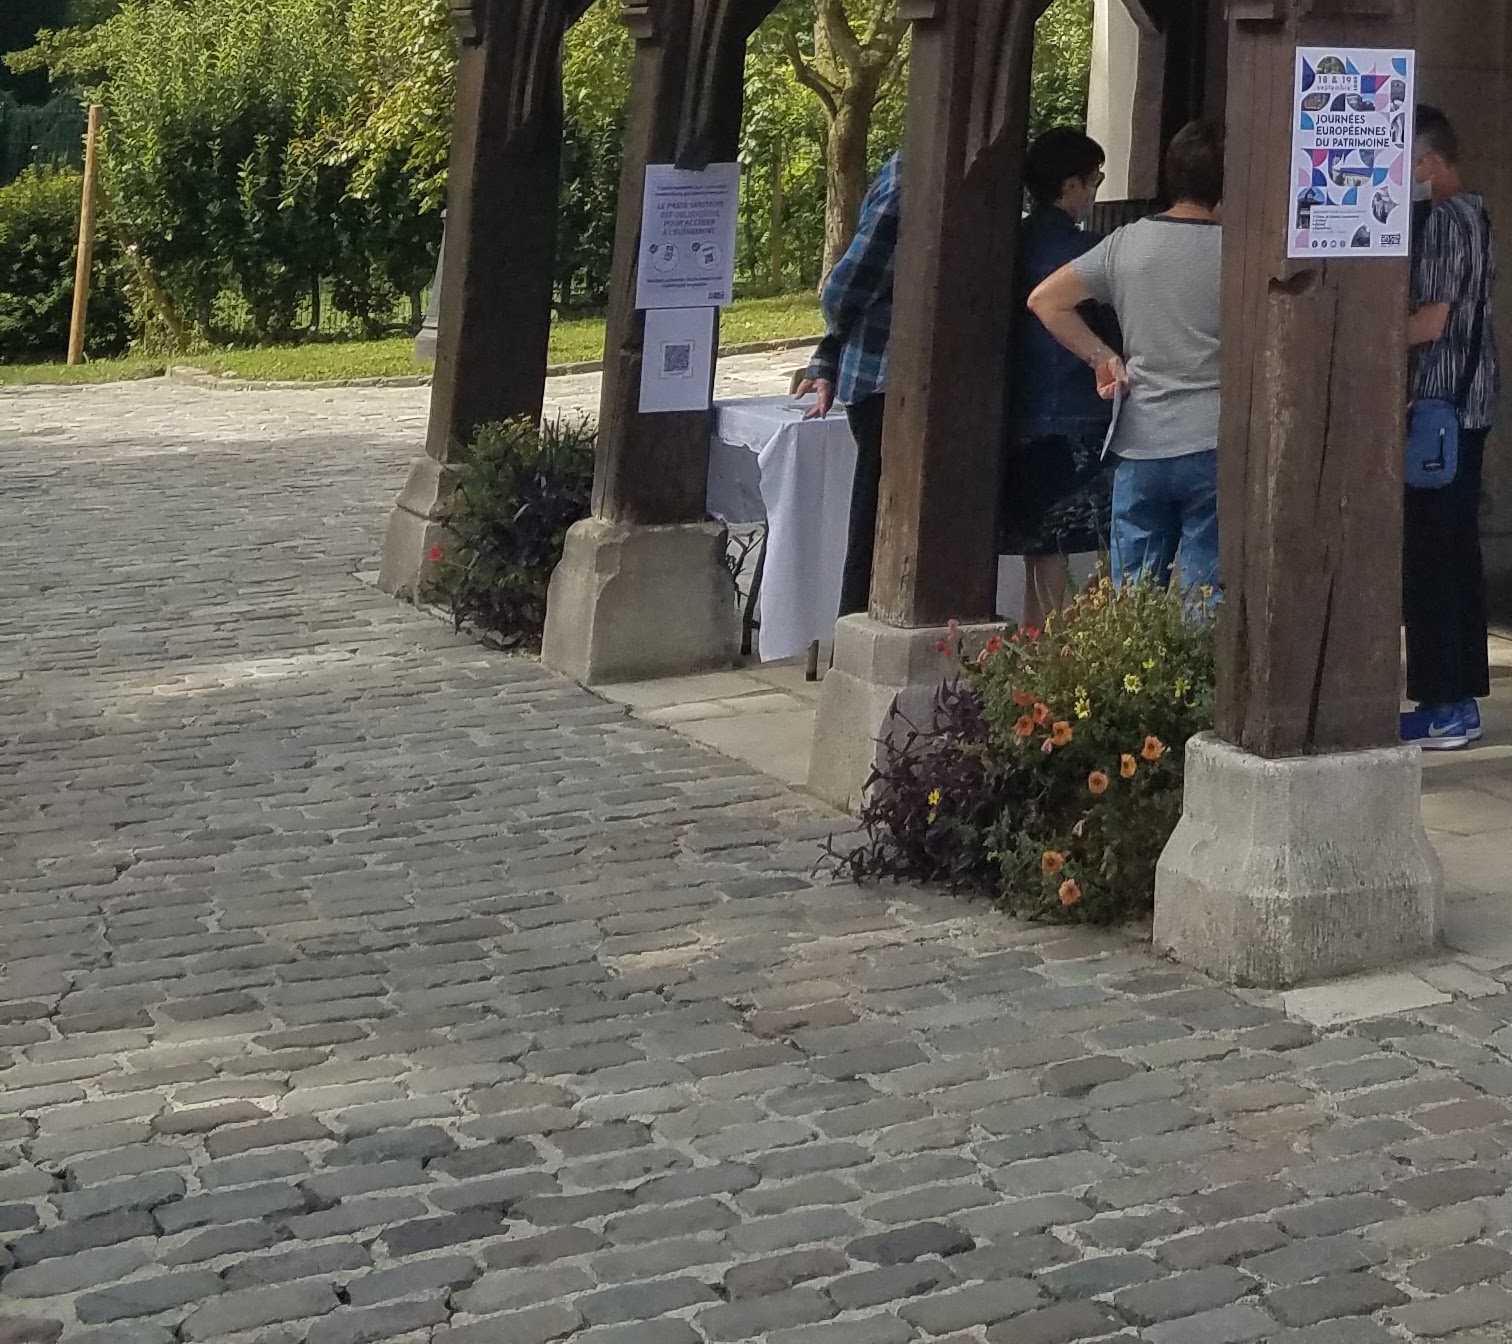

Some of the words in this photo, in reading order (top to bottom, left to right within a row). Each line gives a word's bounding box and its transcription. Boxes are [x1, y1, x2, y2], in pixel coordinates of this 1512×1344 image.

[1342, 75, 1352, 84] 19
[1316, 112, 1366, 124] JOURNÉES
[1316, 124, 1386, 135] EUROPÉENNES
[1315, 137, 1329, 147] DU
[1332, 137, 1390, 147] PATRIMOINE
